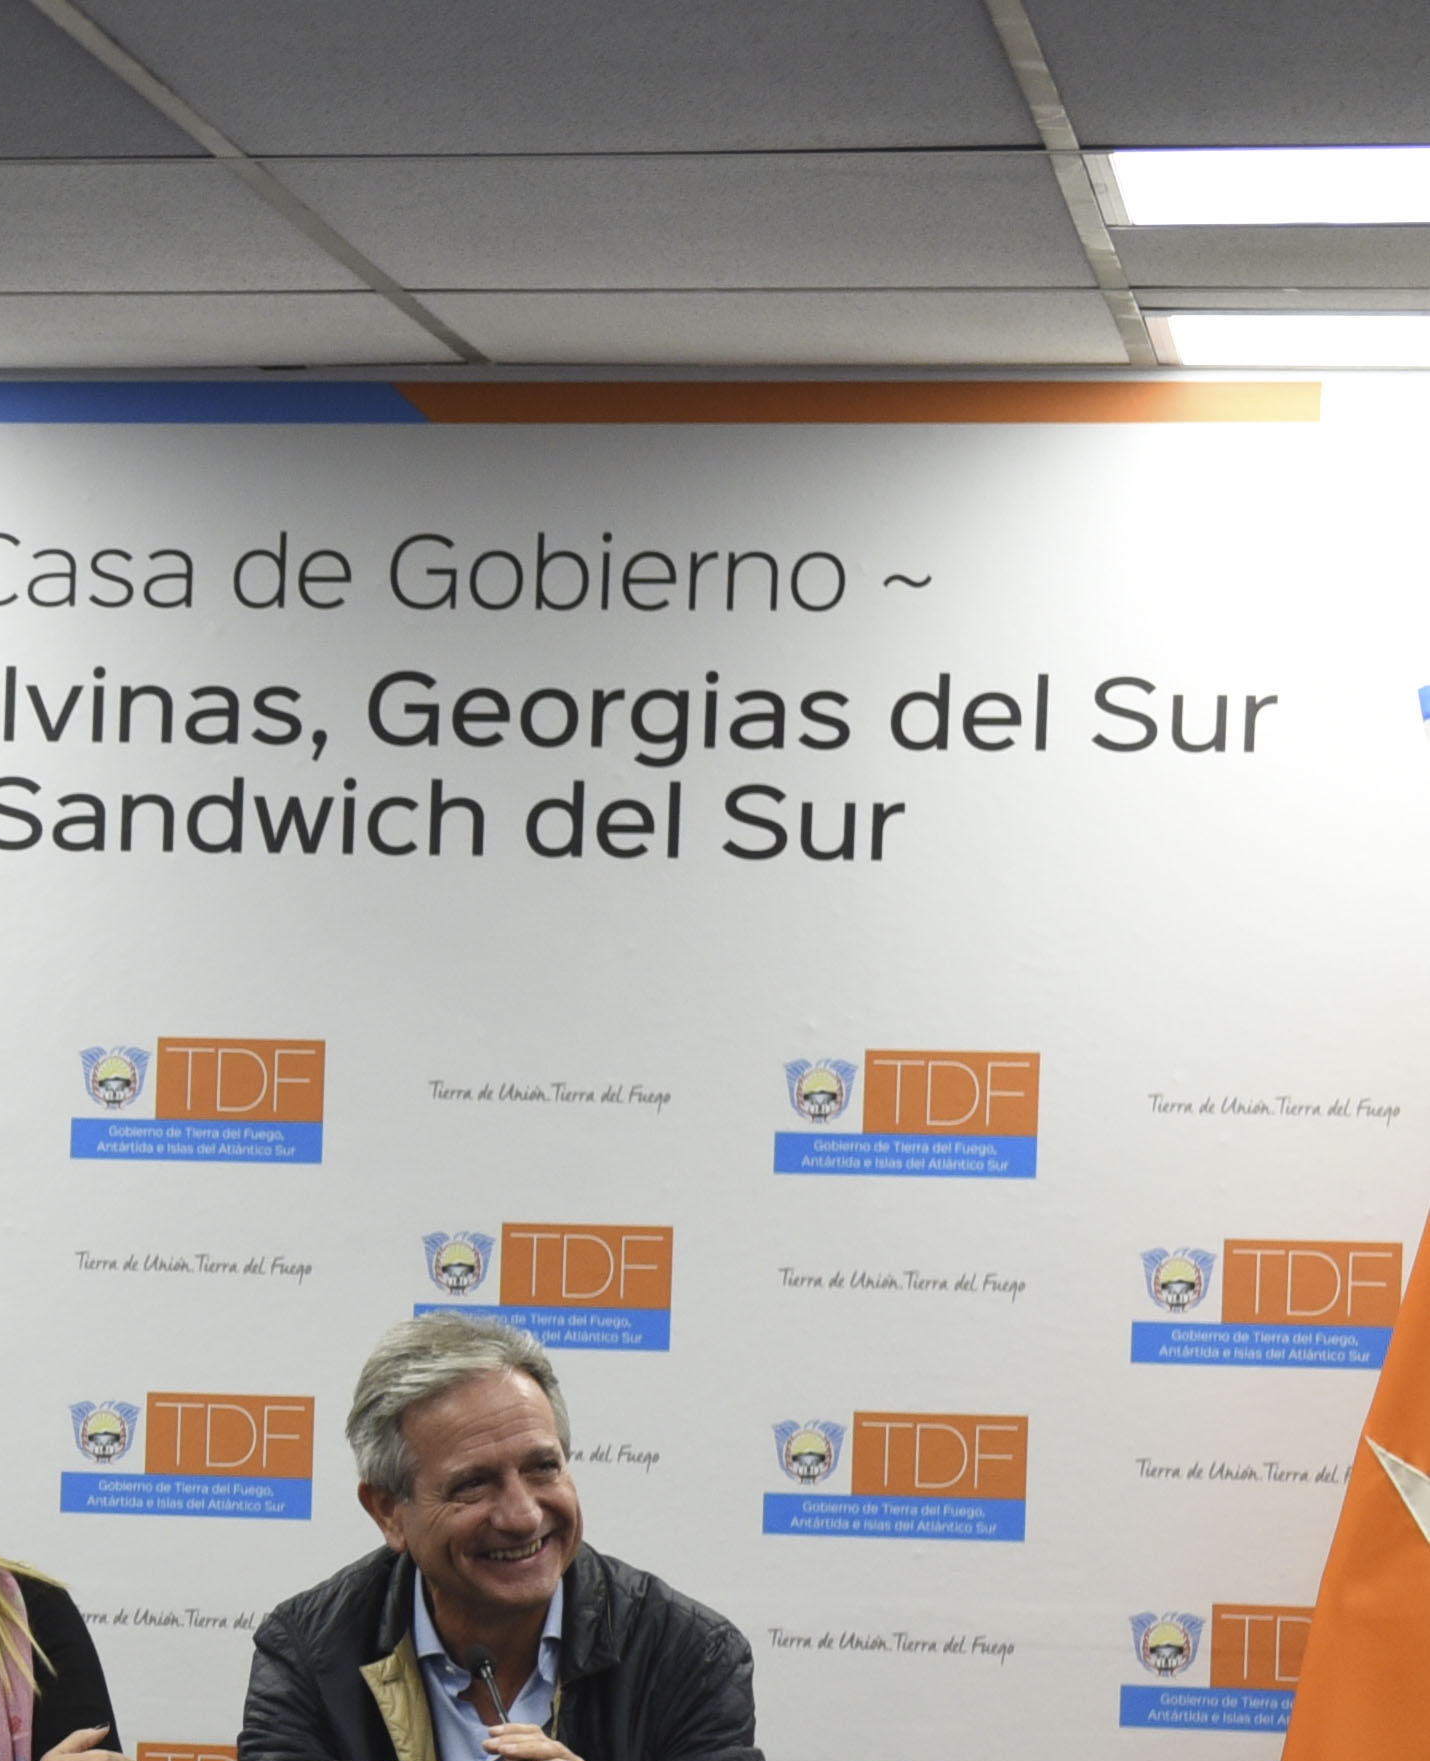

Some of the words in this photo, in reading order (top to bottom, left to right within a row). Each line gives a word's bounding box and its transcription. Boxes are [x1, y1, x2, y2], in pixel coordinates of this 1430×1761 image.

[234, 531, 352, 610] de
[389, 531, 846, 613] Gobierno
[367, 668, 851, 769] Georgias
[891, 673, 1049, 752] del
[1092, 676, 1278, 753] Sur
[525, 778, 682, 860] del
[721, 783, 906, 862] Sur
[165, 1045, 318, 1113] TDF
[429, 1080, 472, 1100] Tierra
[477, 1083, 493, 1100] de
[551, 1082, 595, 1102] Tierra
[601, 1084, 622, 1104] del
[628, 1084, 671, 1116] Fuego
[872, 1058, 1032, 1127] TDF
[1148, 1093, 1193, 1113] Tierra
[1198, 1097, 1215, 1114] de
[1275, 1096, 1322, 1115] Tierra
[1327, 1097, 1350, 1117] del
[1356, 1098, 1401, 1129] Fuego
[510, 1231, 665, 1300] TDF
[778, 1267, 823, 1287] Tierra
[828, 1271, 844, 1288] de
[903, 1270, 948, 1290] Tierra
[954, 1272, 976, 1292] del
[982, 1273, 1026, 1304] Fuego
[1230, 1247, 1395, 1319] TDF
[154, 1401, 307, 1469] TDF
[861, 1421, 1020, 1490] TDF
